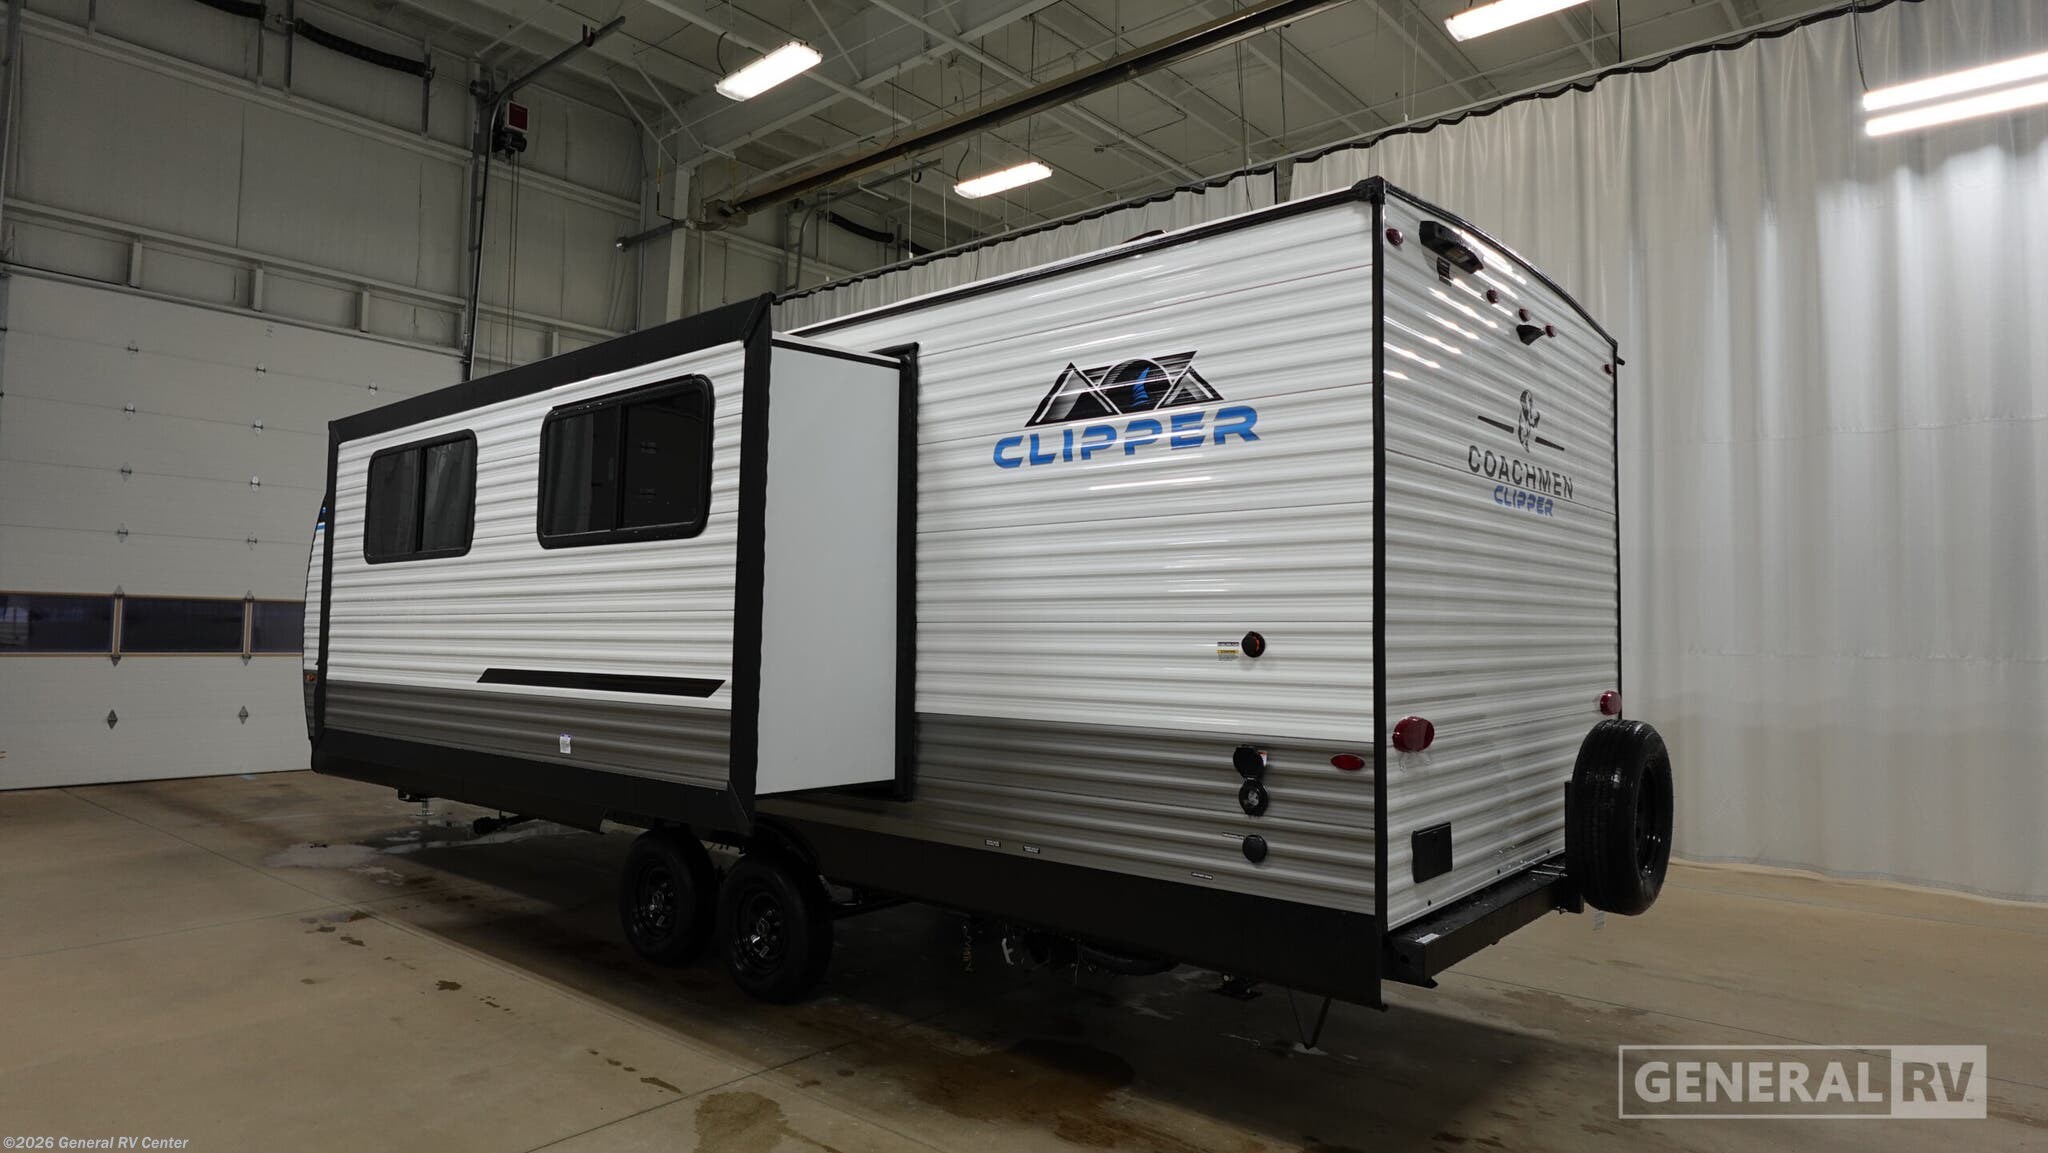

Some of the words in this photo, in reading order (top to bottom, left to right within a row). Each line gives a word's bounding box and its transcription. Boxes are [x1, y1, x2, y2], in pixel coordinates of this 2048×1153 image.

[993, 405, 1261, 469] CLIPPER
[1468, 445, 1573, 500] COACHMEN
[1494, 484, 1553, 516] CLIPPER
